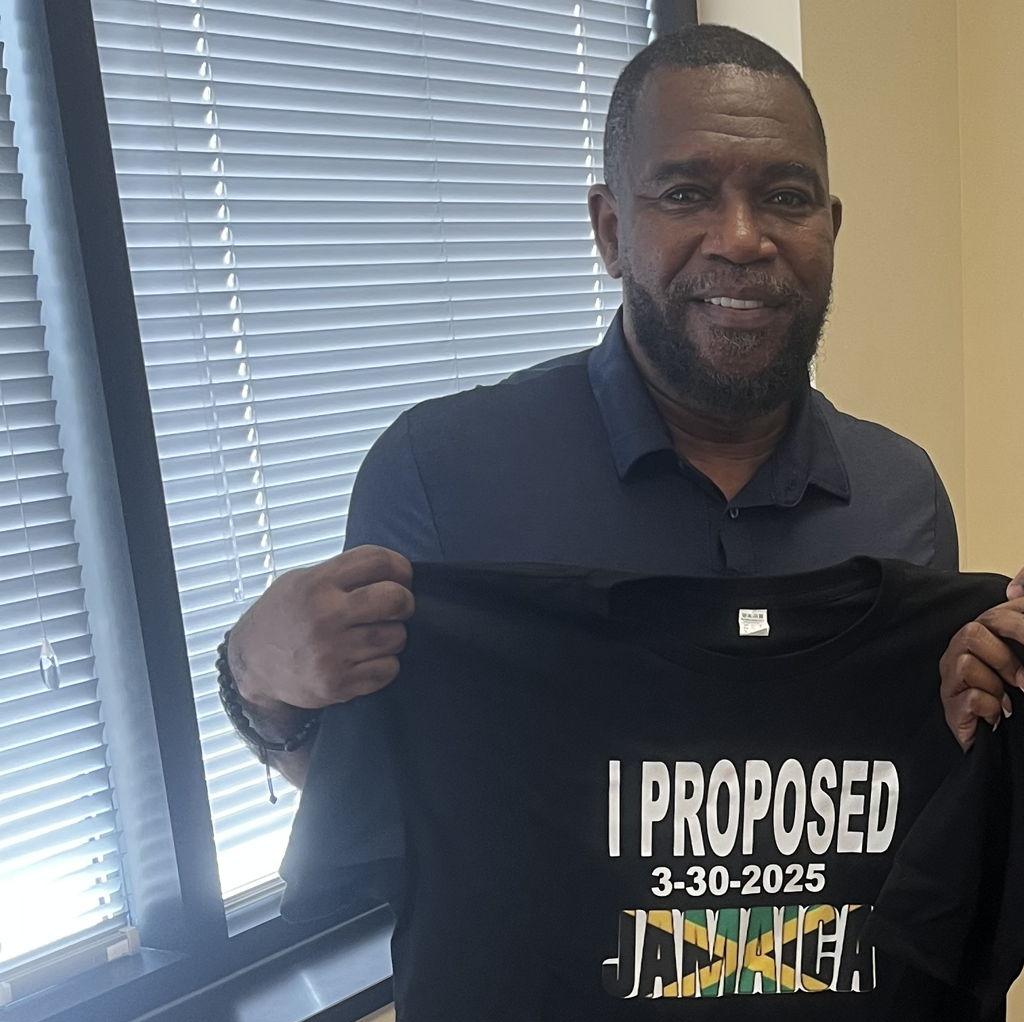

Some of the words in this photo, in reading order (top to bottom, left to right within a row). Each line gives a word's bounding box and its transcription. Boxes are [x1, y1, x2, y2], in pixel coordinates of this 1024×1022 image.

[608, 759, 621, 857] I
[640, 758, 900, 857] PROPOSED
[651, 863, 827, 897] 3-30-2025
[602, 903, 878, 999] JAMAICA
